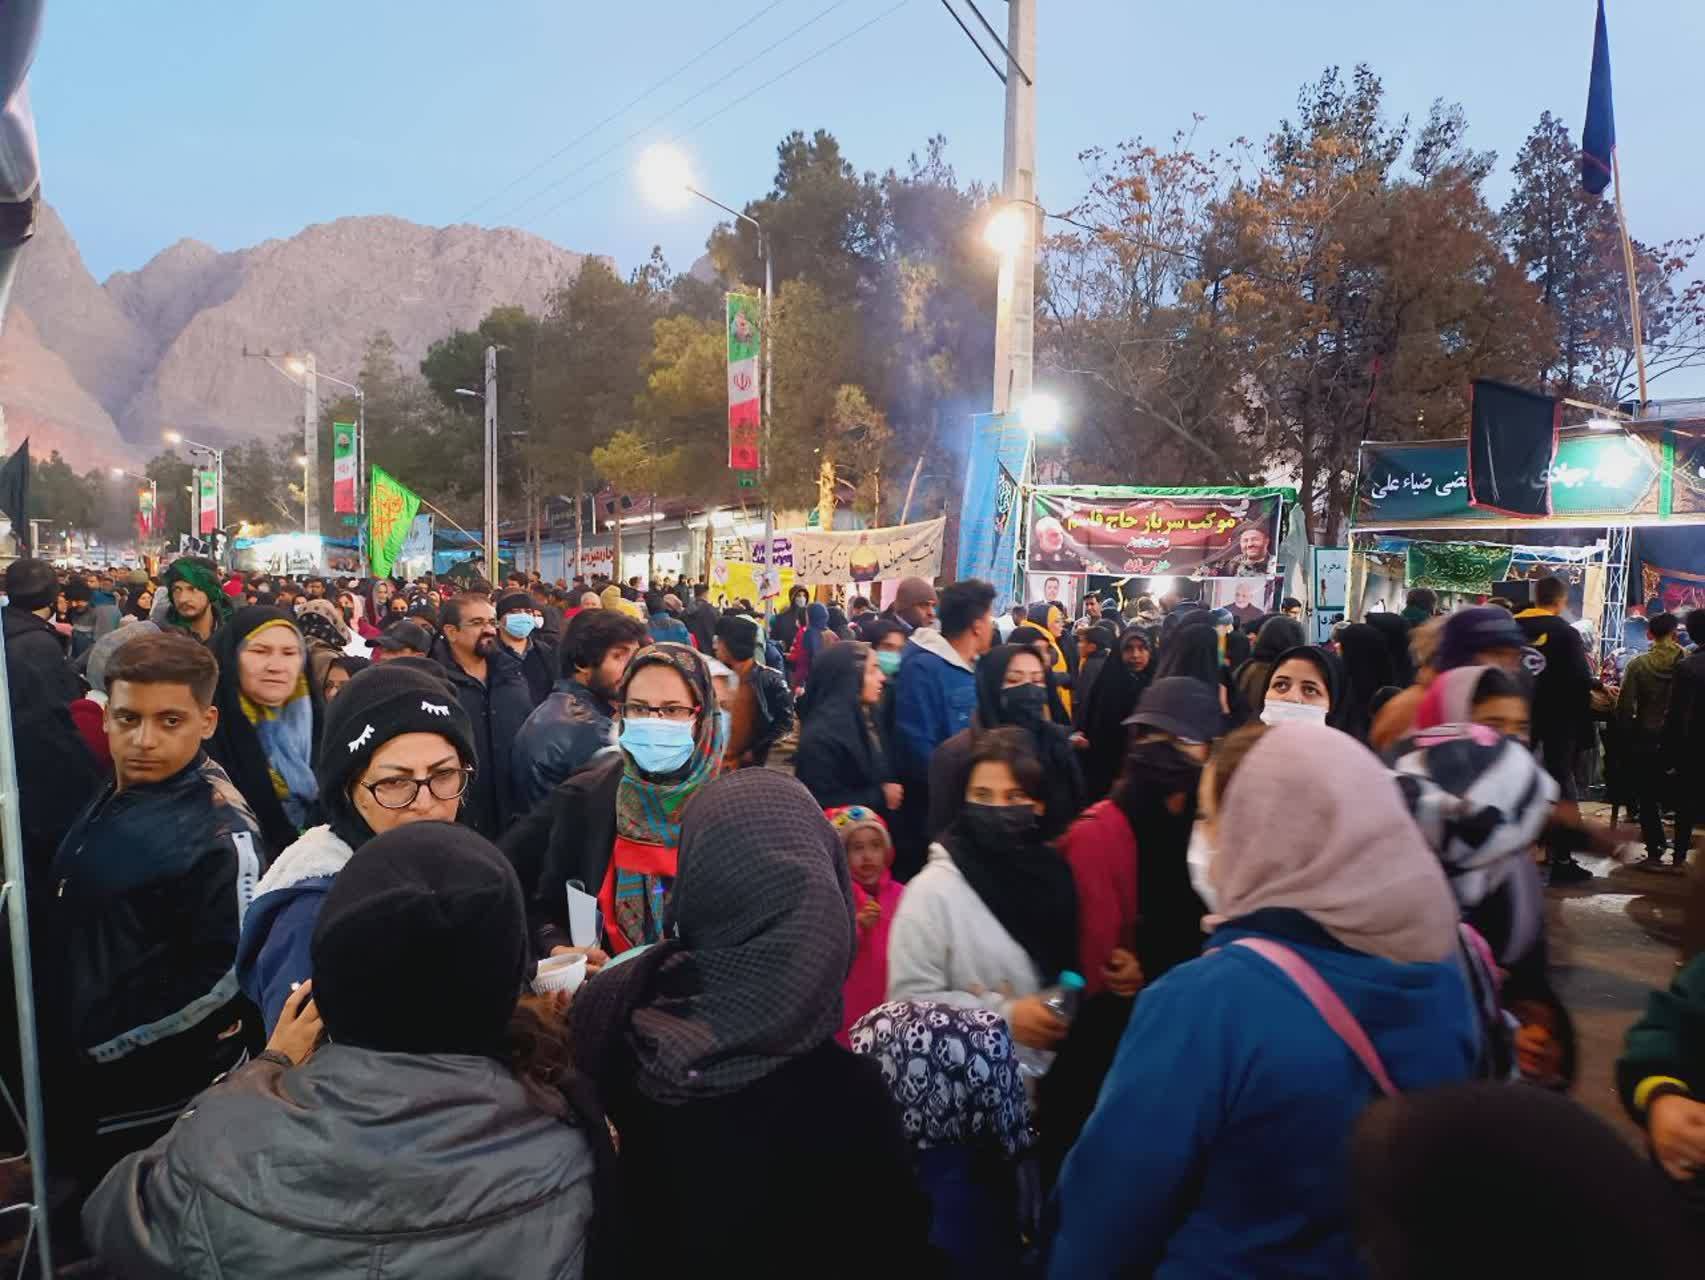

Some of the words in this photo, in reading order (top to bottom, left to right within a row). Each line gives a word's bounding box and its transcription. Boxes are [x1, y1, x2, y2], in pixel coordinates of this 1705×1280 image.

[1067, 509, 1104, 530] قاسم
[1106, 511, 1138, 532] حاج
[1143, 511, 1185, 534] سرباز
[1187, 512, 1236, 534] موکب
